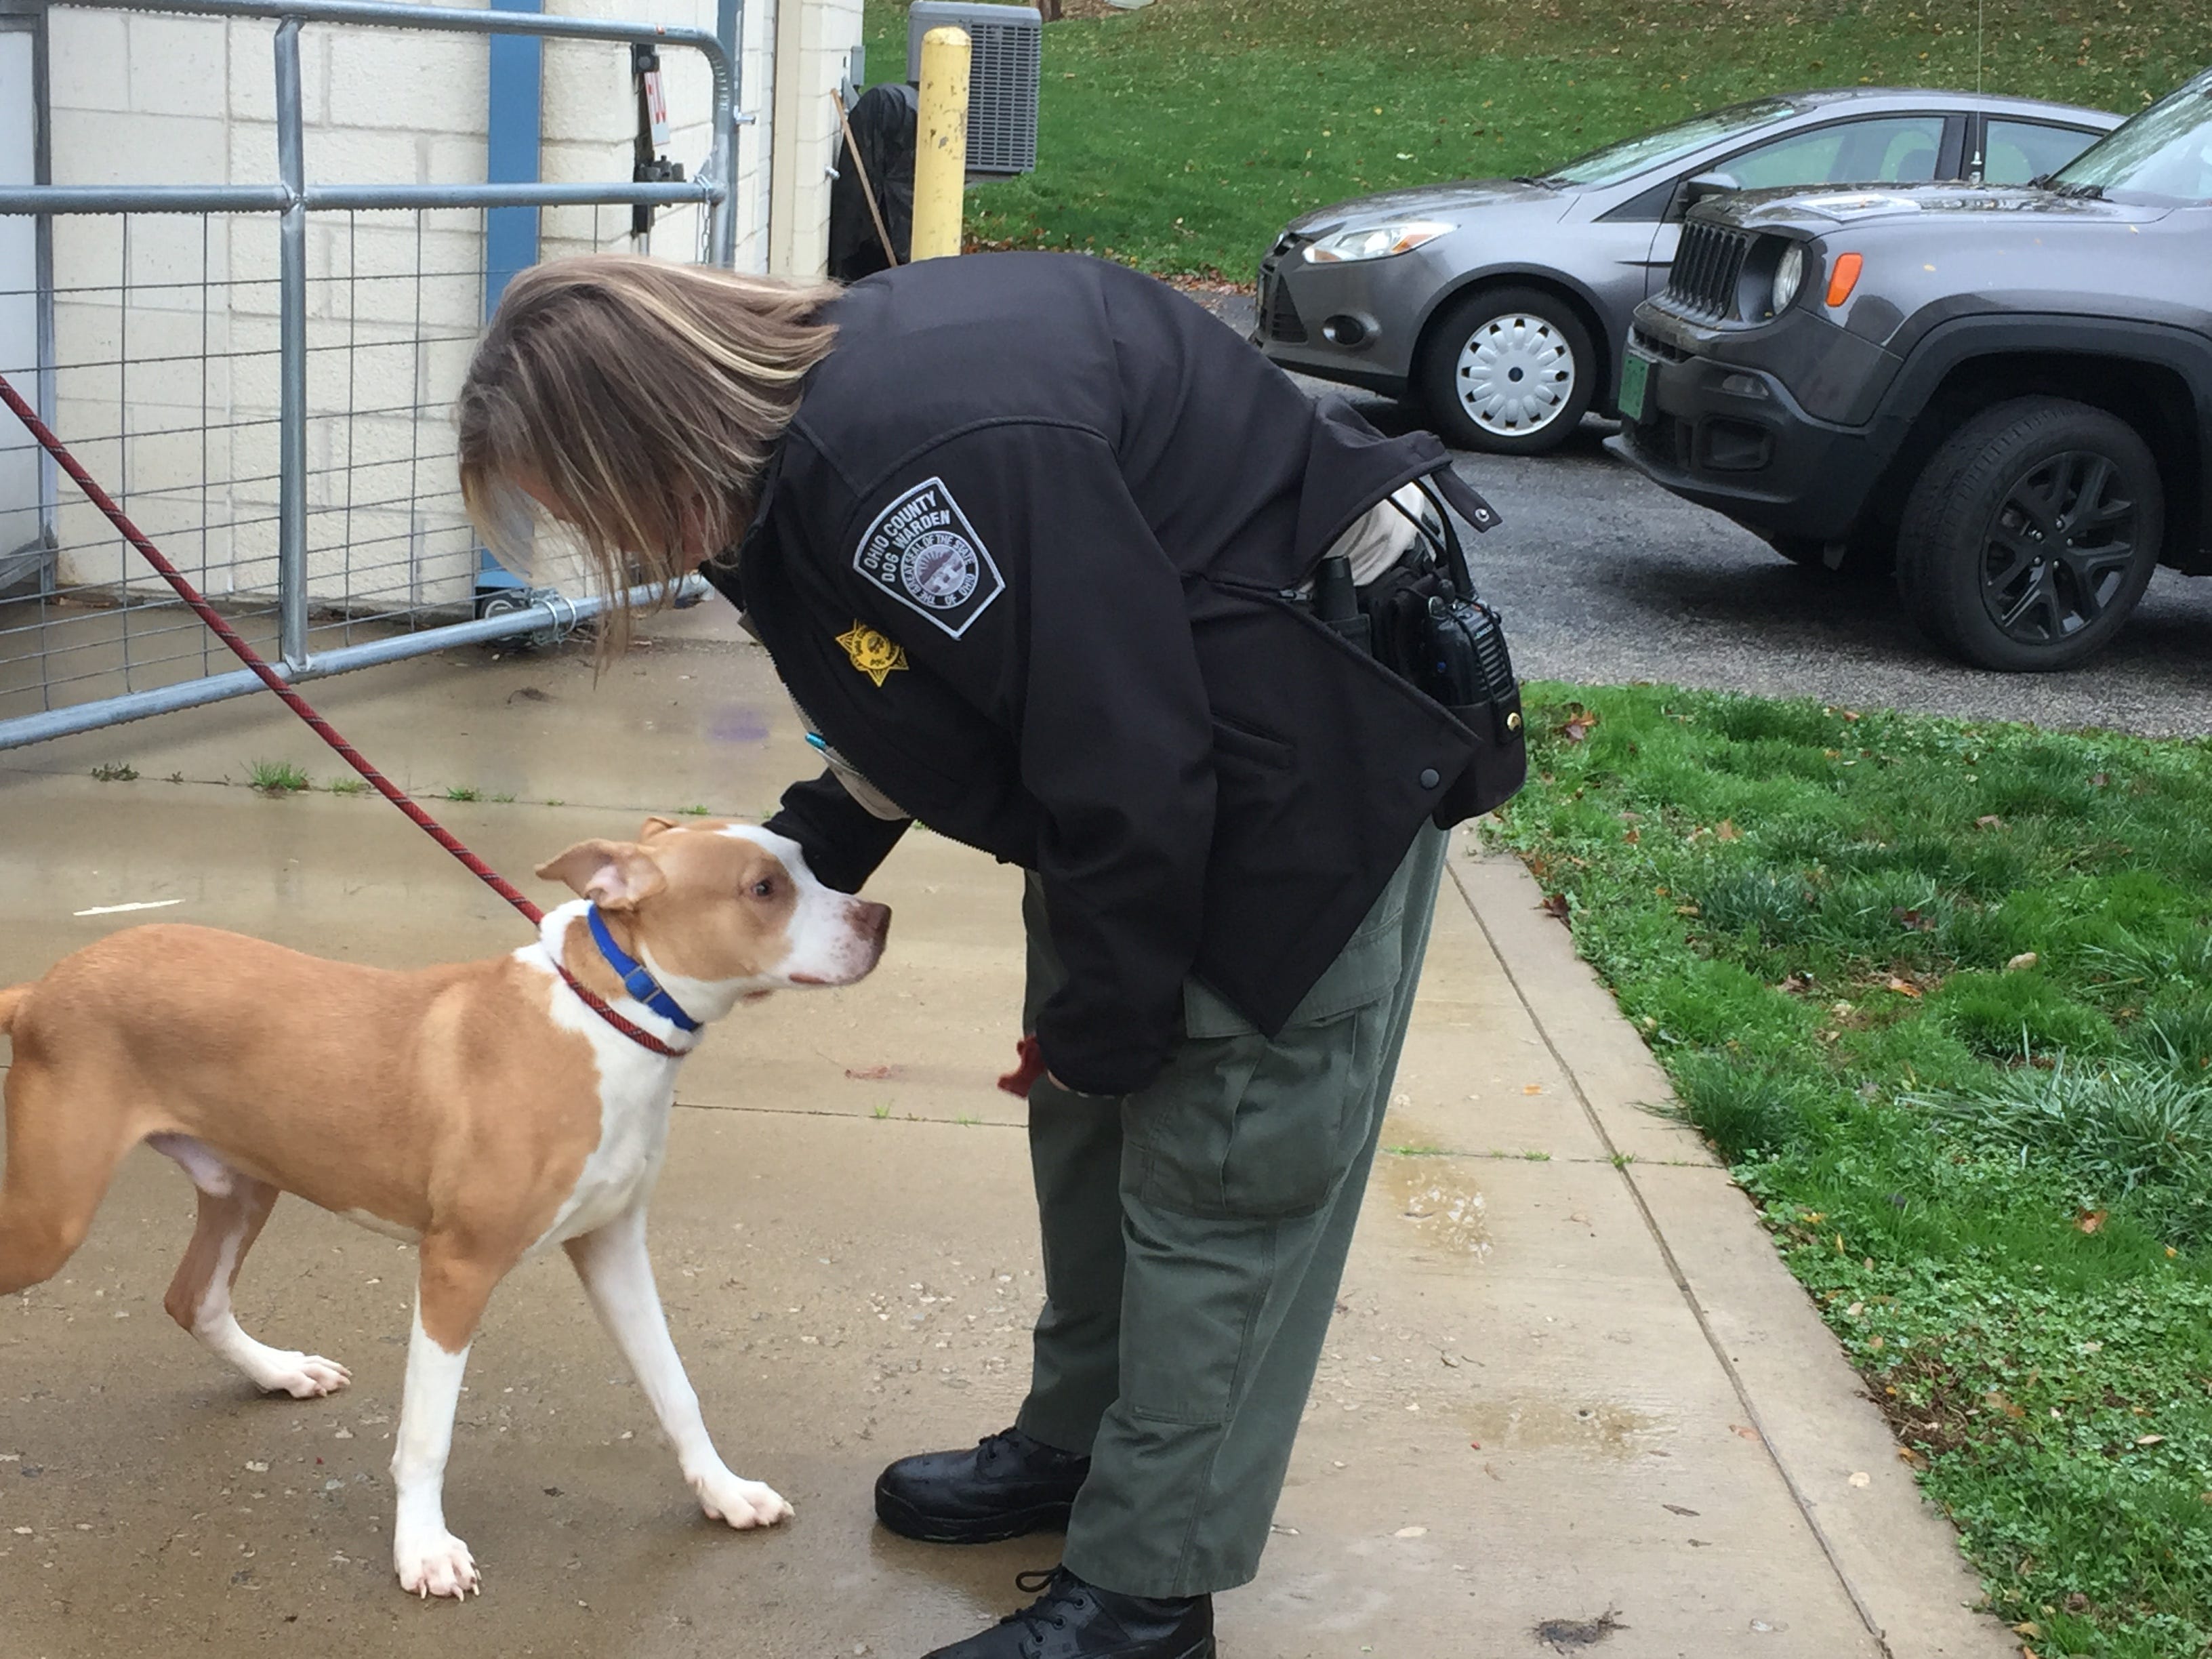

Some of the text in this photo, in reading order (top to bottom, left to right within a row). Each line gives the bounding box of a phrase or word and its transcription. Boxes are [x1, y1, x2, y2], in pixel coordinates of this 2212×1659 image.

[863, 490, 937, 569] OHIO COUNTY
[936, 534, 954, 545] THE
[881, 510, 950, 583] DOG WARDEN
[922, 535, 935, 547] OF
[953, 539, 975, 565] STATE
[905, 543, 924, 564] SEAL
[958, 573, 975, 596] OHIO
[945, 594, 957, 606] OF
